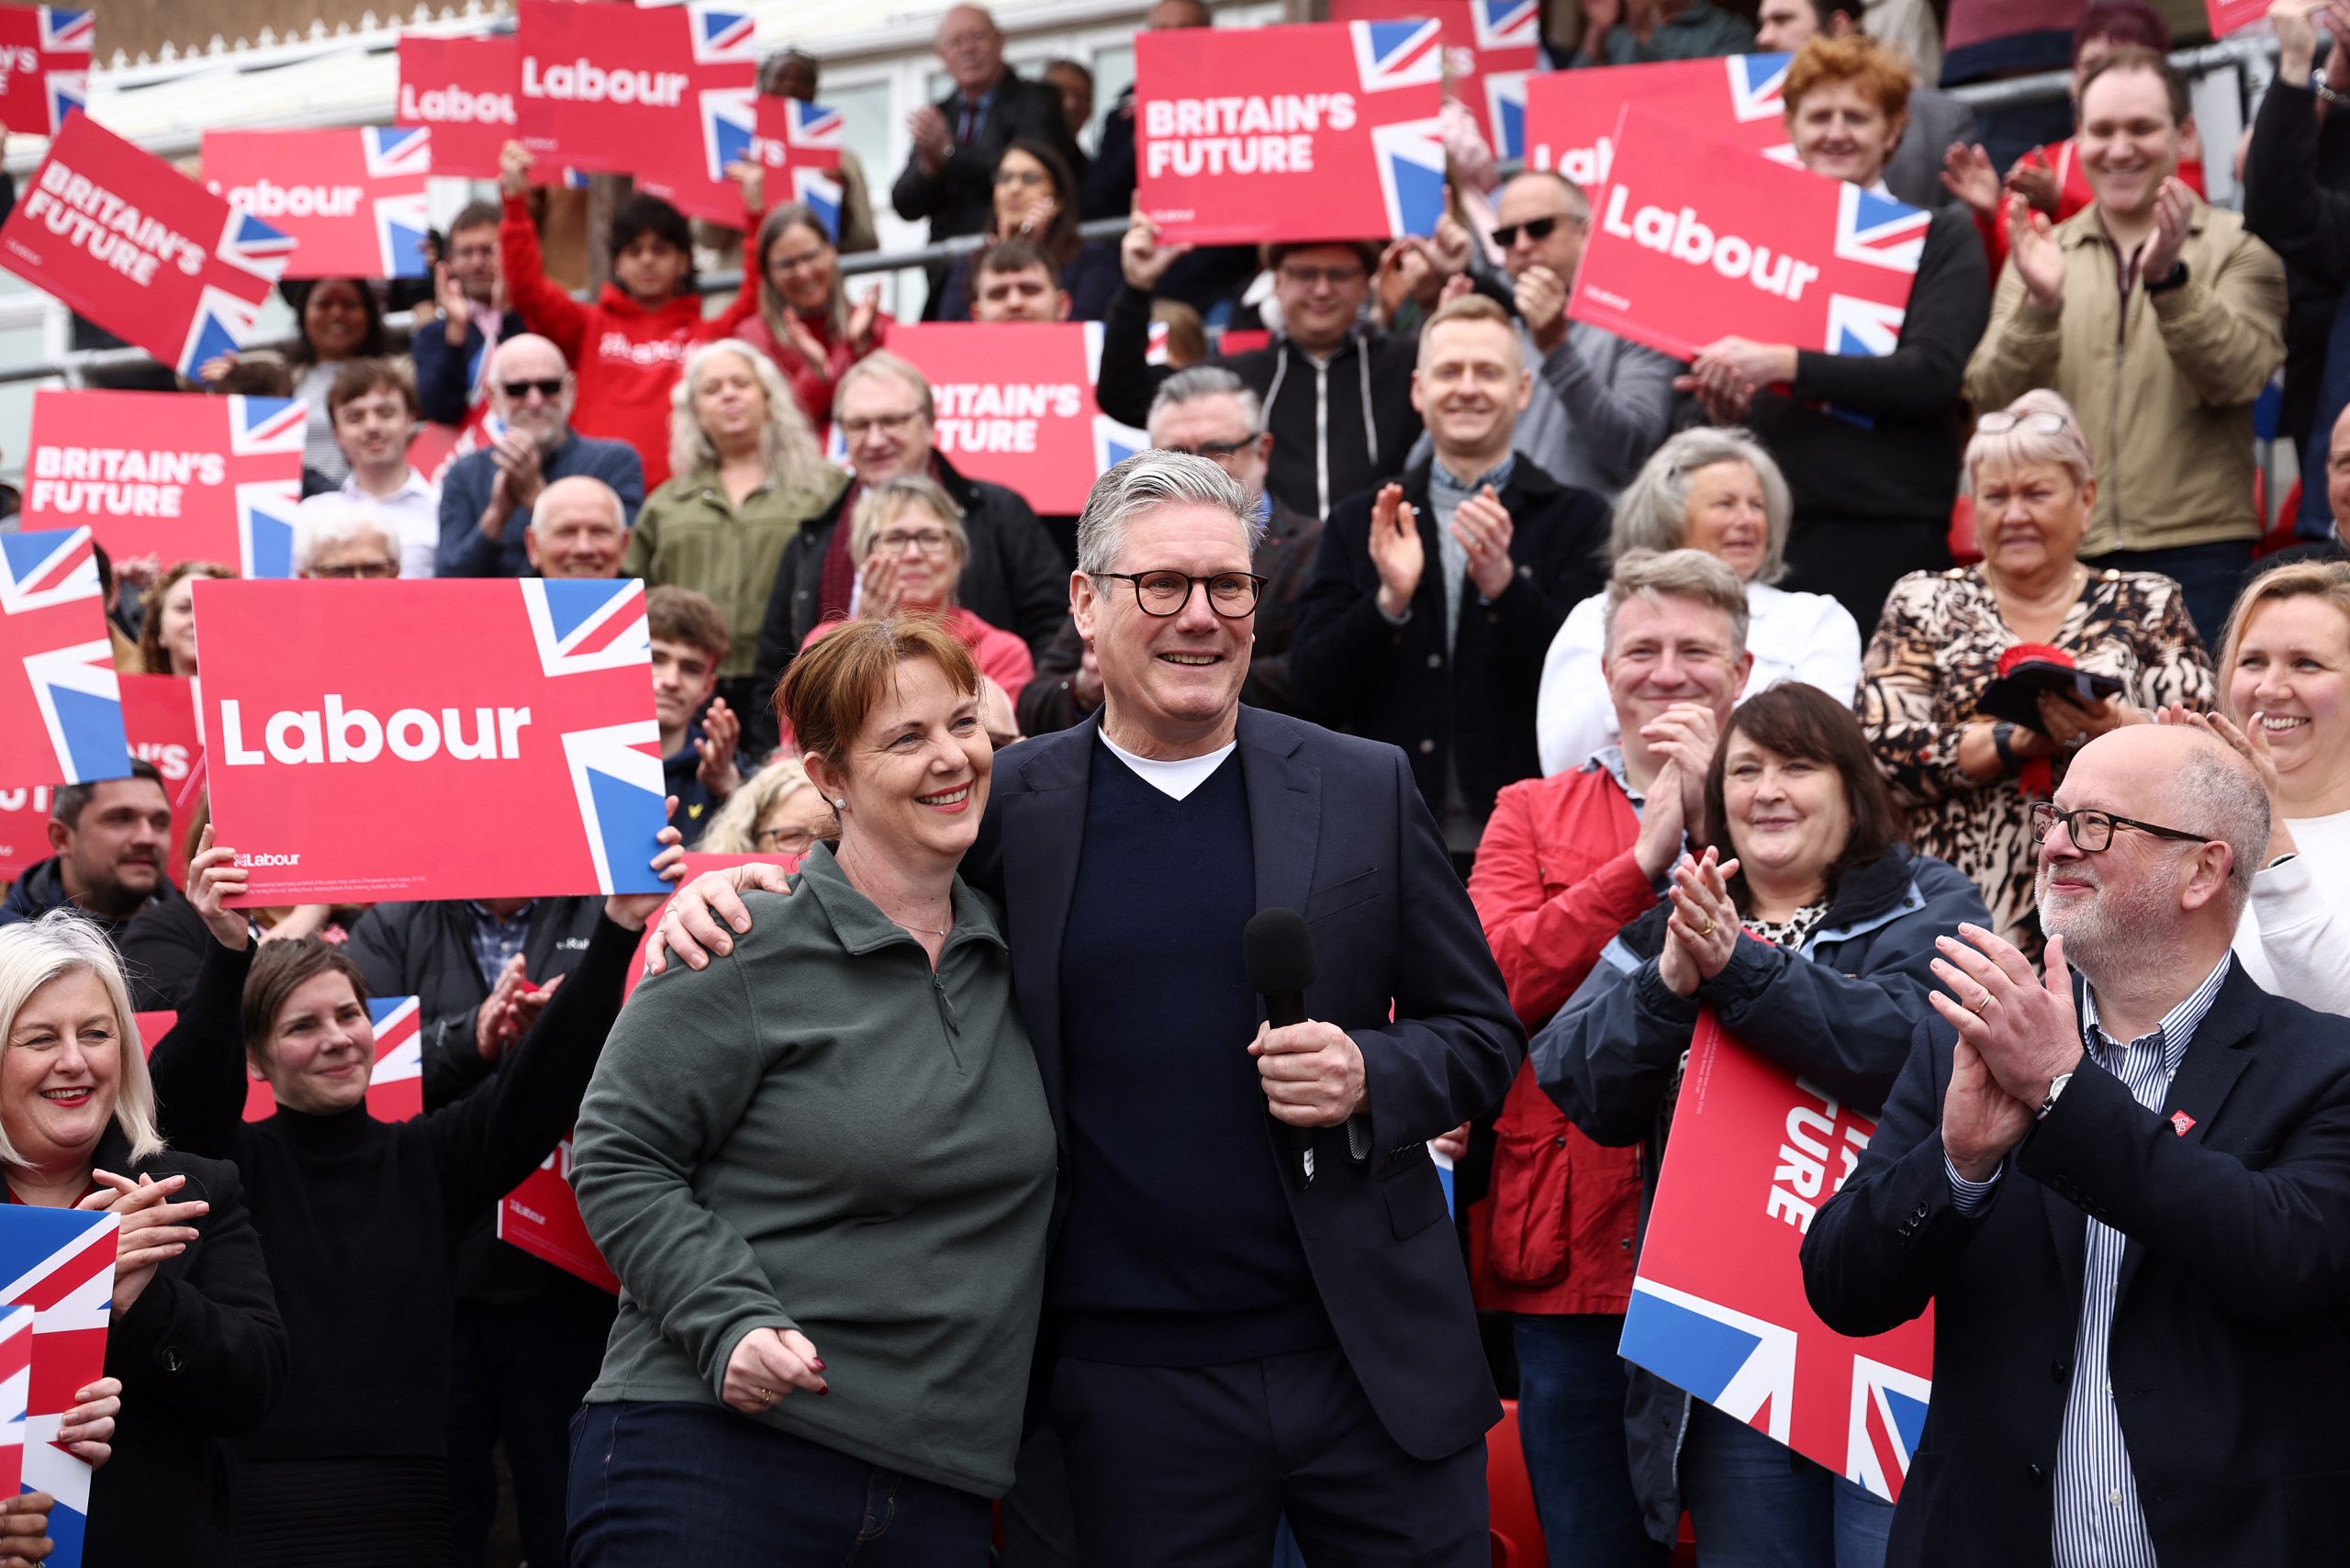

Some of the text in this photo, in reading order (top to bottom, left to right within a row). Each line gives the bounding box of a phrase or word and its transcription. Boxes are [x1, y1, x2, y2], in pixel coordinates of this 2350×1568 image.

[522, 56, 688, 107] Labour
[1147, 93, 1357, 137] BRITAIN'S
[1147, 134, 1315, 178] FUTURE
[39, 159, 207, 275] BRITAIN'S
[207, 178, 364, 218] abour
[24, 187, 161, 287] FUTURE
[1603, 184, 1819, 302] Labour
[931, 383, 1081, 418] ITAIN'S
[934, 419, 1038, 453] TURE
[34, 445, 225, 486] BRITAIN'S
[31, 479, 183, 518] FUTURE
[220, 694, 532, 766] Labour
[247, 853, 301, 867] Labour
